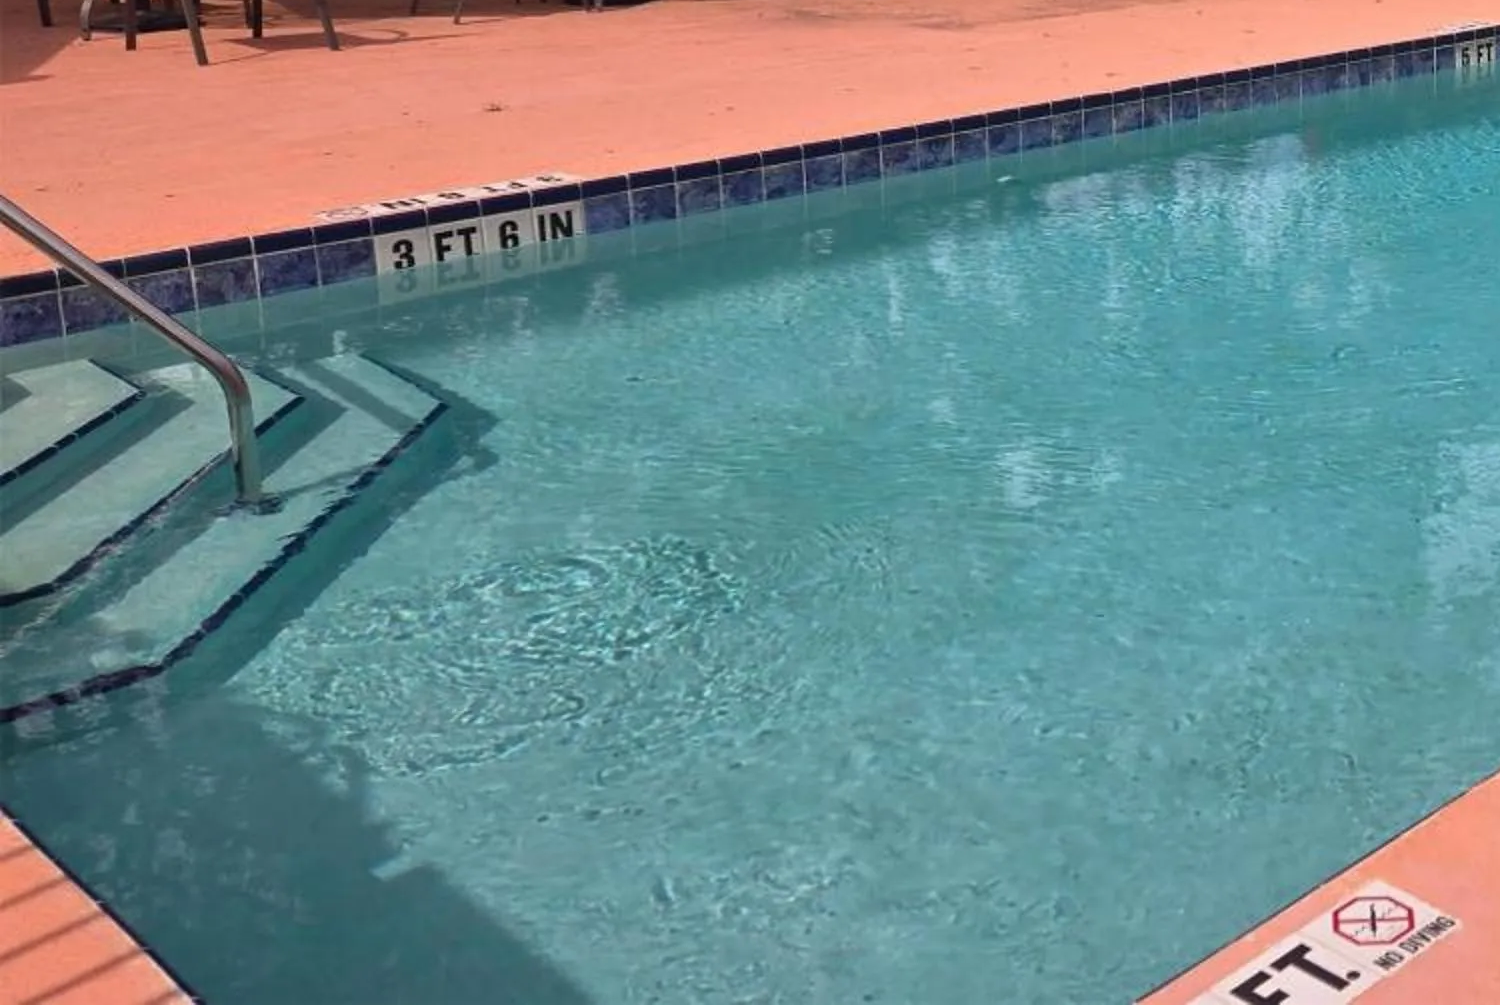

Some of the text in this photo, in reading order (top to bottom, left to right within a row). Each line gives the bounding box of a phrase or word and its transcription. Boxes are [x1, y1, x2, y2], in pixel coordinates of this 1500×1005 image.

[1477, 42, 1493, 64] FT
[391, 209, 574, 270] 3 FT 6 IN
[1373, 914, 1456, 971] NO DIVING
